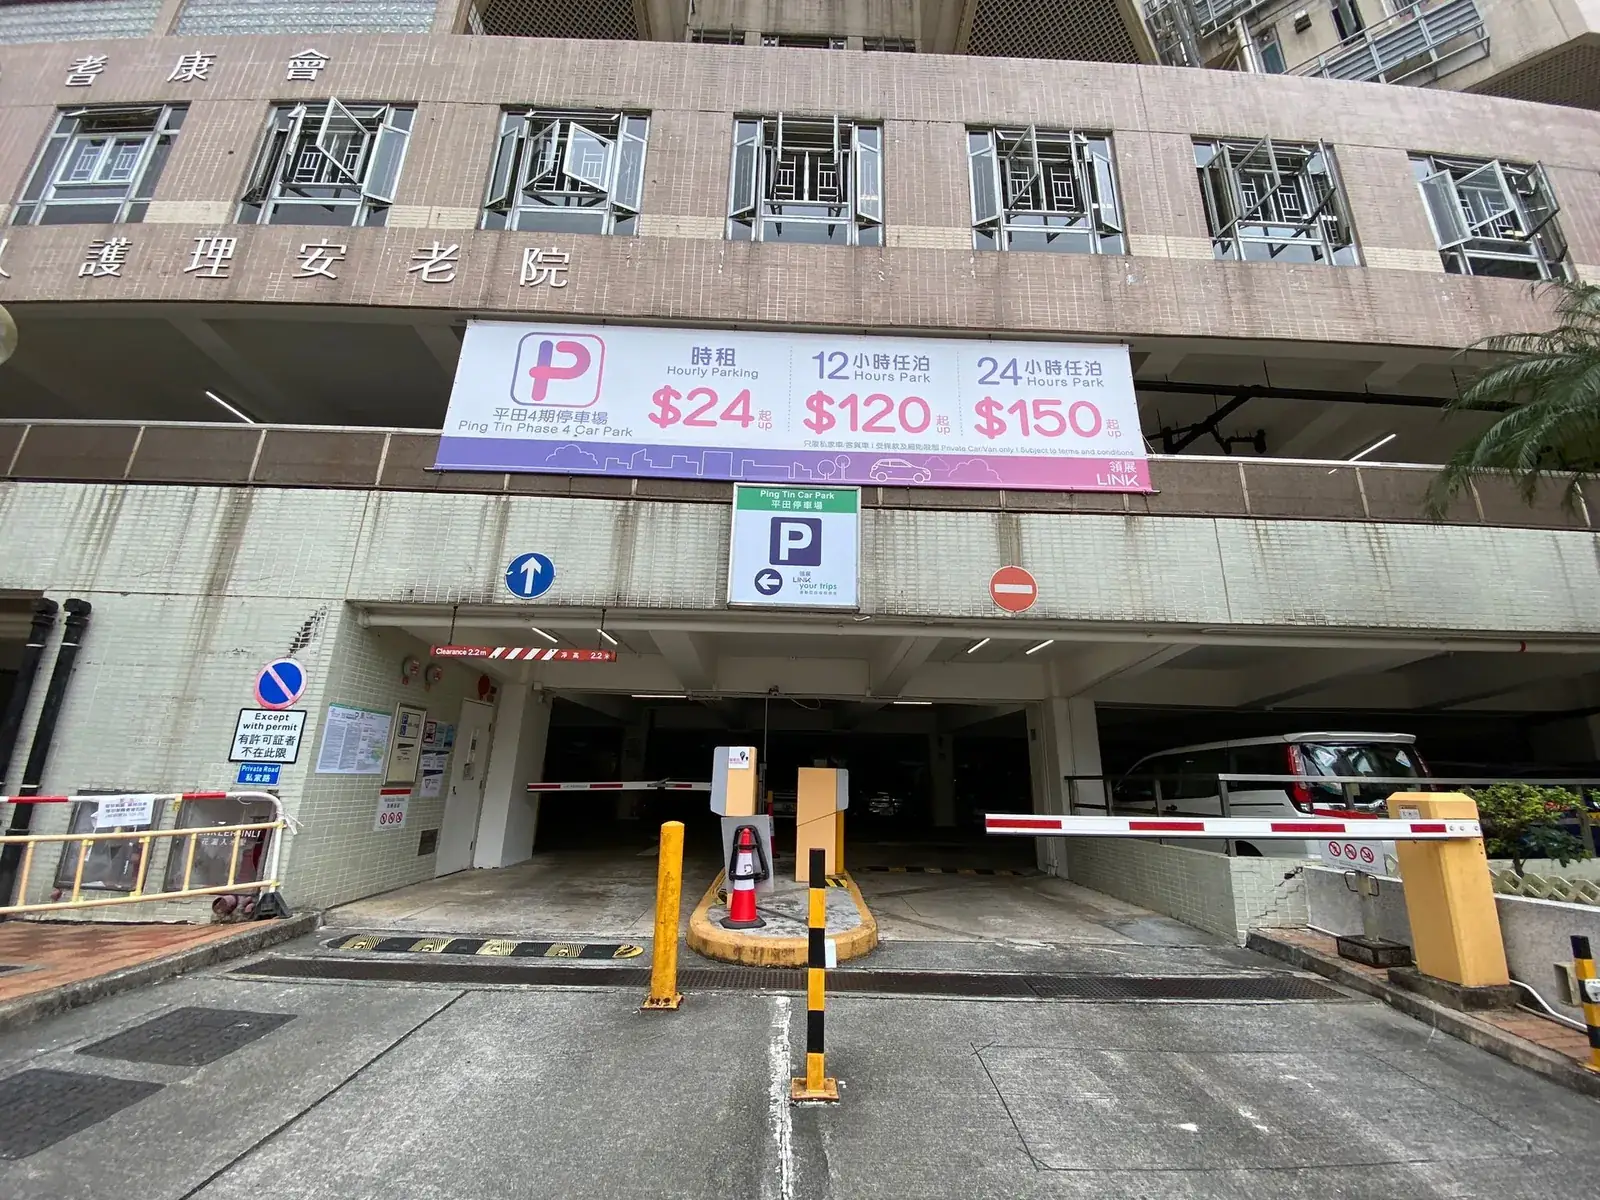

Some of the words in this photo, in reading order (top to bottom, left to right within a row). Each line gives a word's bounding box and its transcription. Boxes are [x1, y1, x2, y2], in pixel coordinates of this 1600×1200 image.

[65, 48, 331, 87] 耆康會
[0, 236, 570, 288] 護理安老院
[691, 346, 737, 367] 時租
[667, 365, 708, 379] Hourly
[712, 367, 759, 380] Parking
[812, 351, 850, 380] 12
[853, 354, 930, 373] 小時任泊
[977, 356, 1023, 386] 24
[1025, 359, 1103, 377] 小時任泊
[853, 371, 895, 382] Hours
[900, 372, 931, 383] Park
[1027, 376, 1069, 388] Hours
[1073, 377, 1104, 388] Park
[648, 385, 755, 429] $24
[803, 390, 931, 435] $120
[493, 407, 609, 425] 平田4期停車場
[974, 396, 1102, 439] $150
[458, 420, 489, 435] Ping
[493, 421, 513, 433] Tin
[517, 422, 559, 435] Phase
[562, 423, 571, 435] 4
[575, 424, 599, 437] Car
[603, 425, 633, 438] Park
[758, 421, 773, 431] up
[936, 426, 950, 436] up
[1106, 429, 1122, 439] up
[941, 444, 966, 452] Private
[1020, 446, 1048, 455] Subject
[1096, 473, 1140, 487] LINK
[760, 490, 780, 499] Ping
[782, 490, 795, 498] Tin
[798, 491, 813, 499] Car
[815, 491, 834, 500] Park
[779, 522, 812, 560] P
[436, 647, 467, 656] Clearance
[255, 712, 290, 722] Except
[243, 722, 264, 730] with
[265, 723, 298, 731] permit
[241, 746, 287, 758] 不在此限
[245, 773, 271, 782] 私家路
